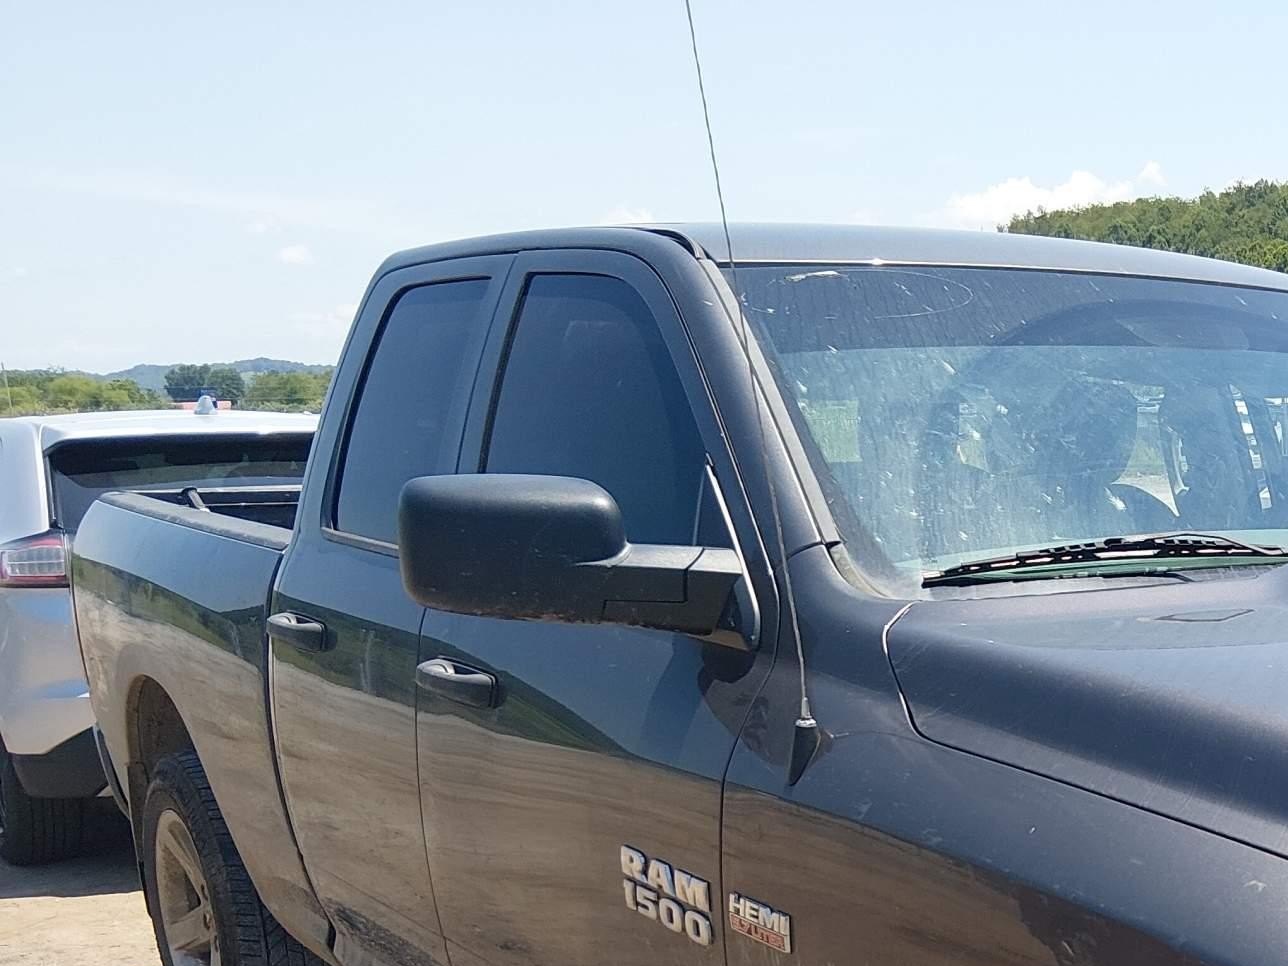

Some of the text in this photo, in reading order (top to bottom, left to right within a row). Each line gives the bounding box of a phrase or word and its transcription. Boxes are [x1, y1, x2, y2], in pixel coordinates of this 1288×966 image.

[620, 844, 710, 912] RAM
[623, 878, 713, 946] 1500
[729, 892, 790, 936] HEMI
